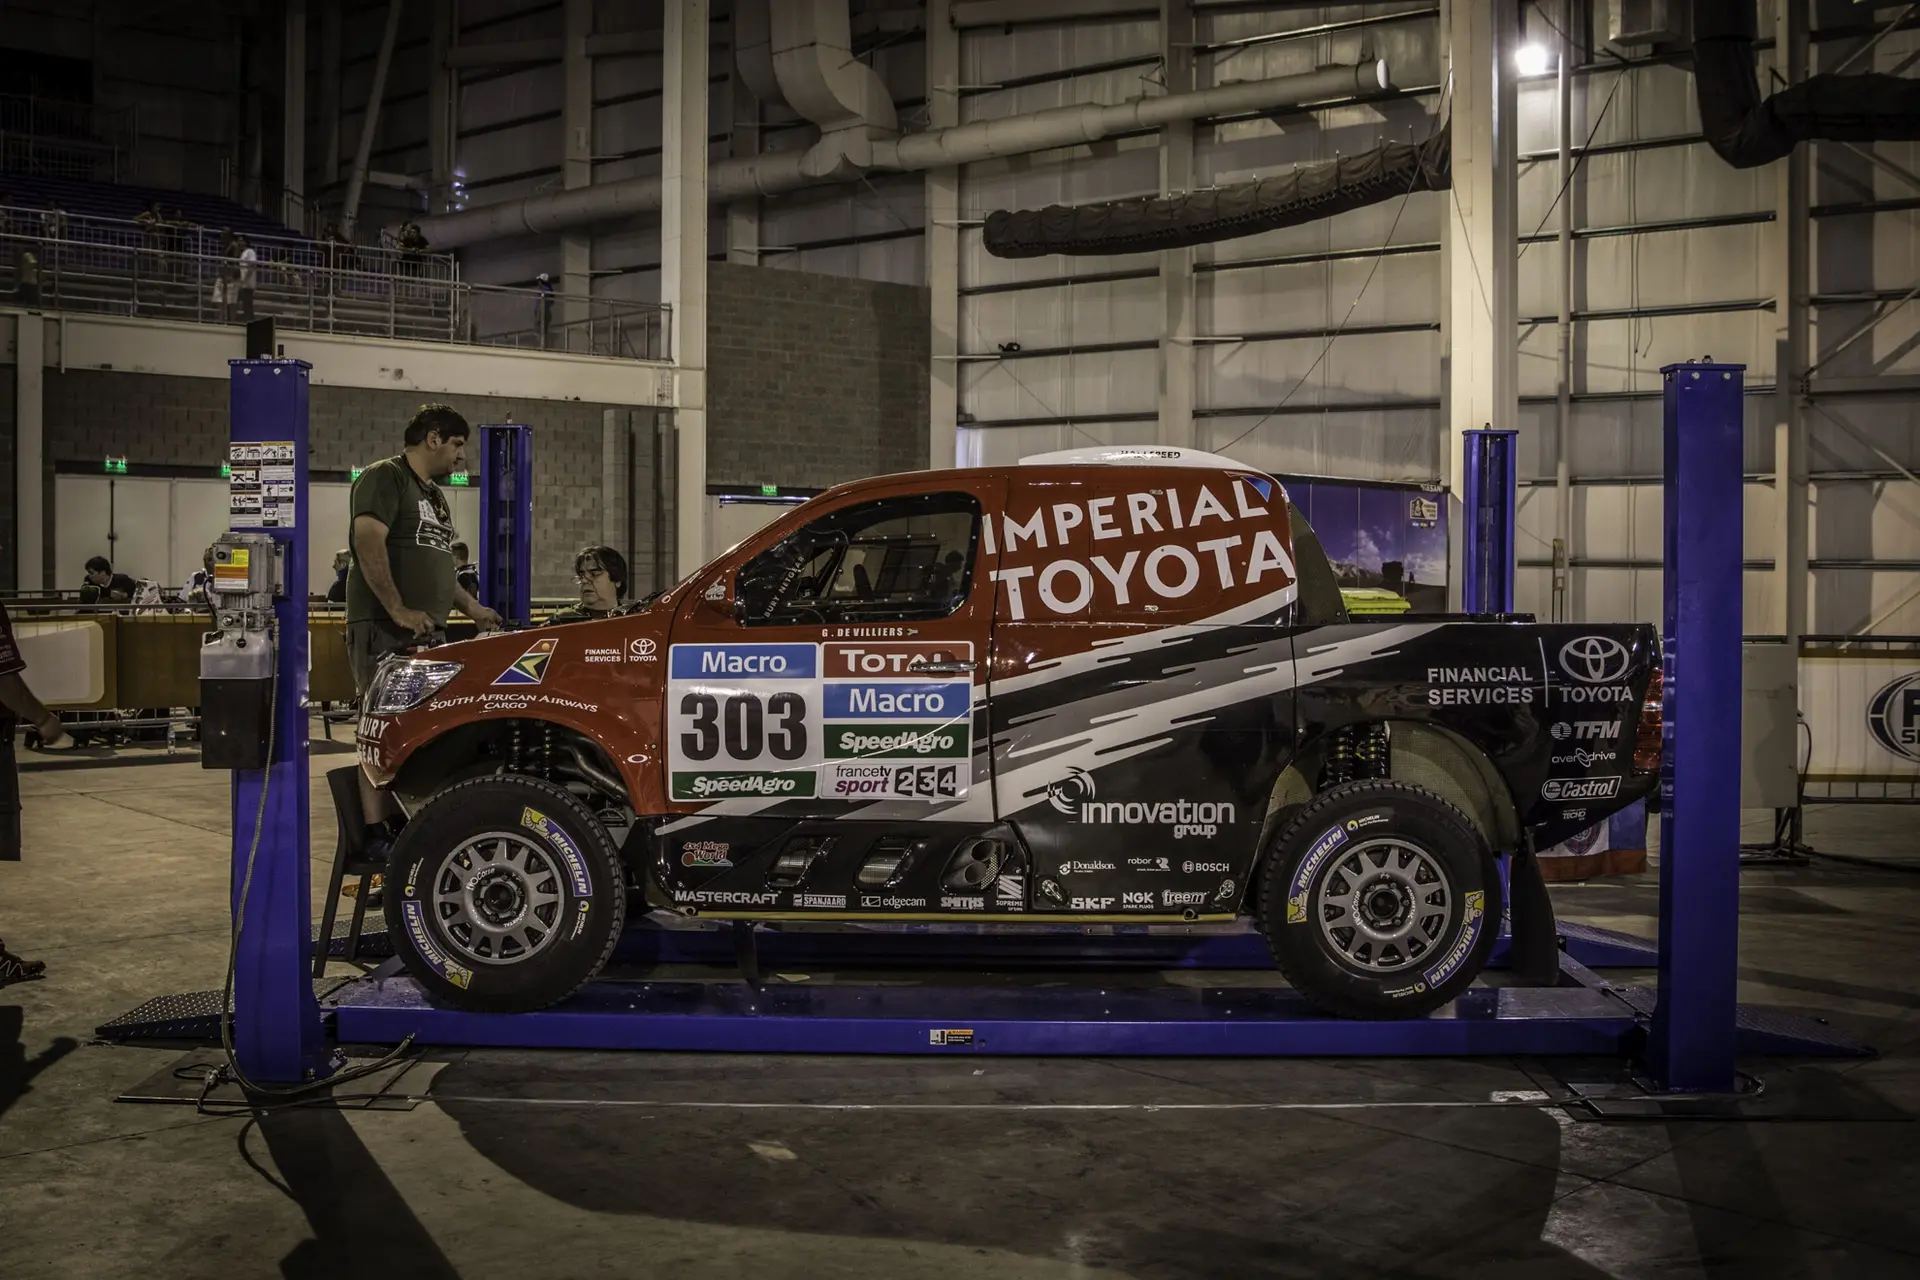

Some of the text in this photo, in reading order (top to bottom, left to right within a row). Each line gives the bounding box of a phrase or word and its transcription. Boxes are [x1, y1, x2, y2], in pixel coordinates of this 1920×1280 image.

[982, 480, 1269, 554] IMPERIAL
[989, 530, 1297, 620] TOYOTA
[763, 595, 780, 618] BURY
[853, 627, 903, 637] VILLIERS
[701, 651, 787, 673] Macro
[1427, 667, 1533, 683] FINANCIAL
[428, 693, 598, 713] SOUTH AFRICAN AIRWAYS
[849, 690, 945, 713] Macro
[1428, 687, 1533, 705] SERVICES
[1559, 686, 1634, 703] TOYOTA
[680, 692, 807, 761] 303
[1573, 721, 1622, 739] TFM
[839, 732, 954, 753] SpeedAgro
[692, 777, 796, 795] SpeedAgro
[835, 778, 888, 796] sport
[1561, 780, 1615, 798] Castrol
[1081, 798, 1235, 824] innovation
[1173, 824, 1217, 839] group
[551, 832, 587, 894] MICHELIN
[693, 850, 728, 861] World
[1127, 857, 1152, 865] robor
[1298, 830, 1342, 888] MICHELIN
[1195, 863, 1230, 871] BOSCH
[675, 890, 778, 904] MASTERCRAFT
[804, 896, 846, 906] SPANJAARD
[882, 895, 926, 909] edgecam
[1071, 897, 1115, 909] SKF
[1123, 892, 1154, 904] NGK
[406, 904, 442, 965] MICHELIN
[1431, 926, 1475, 984] MICHELIN
